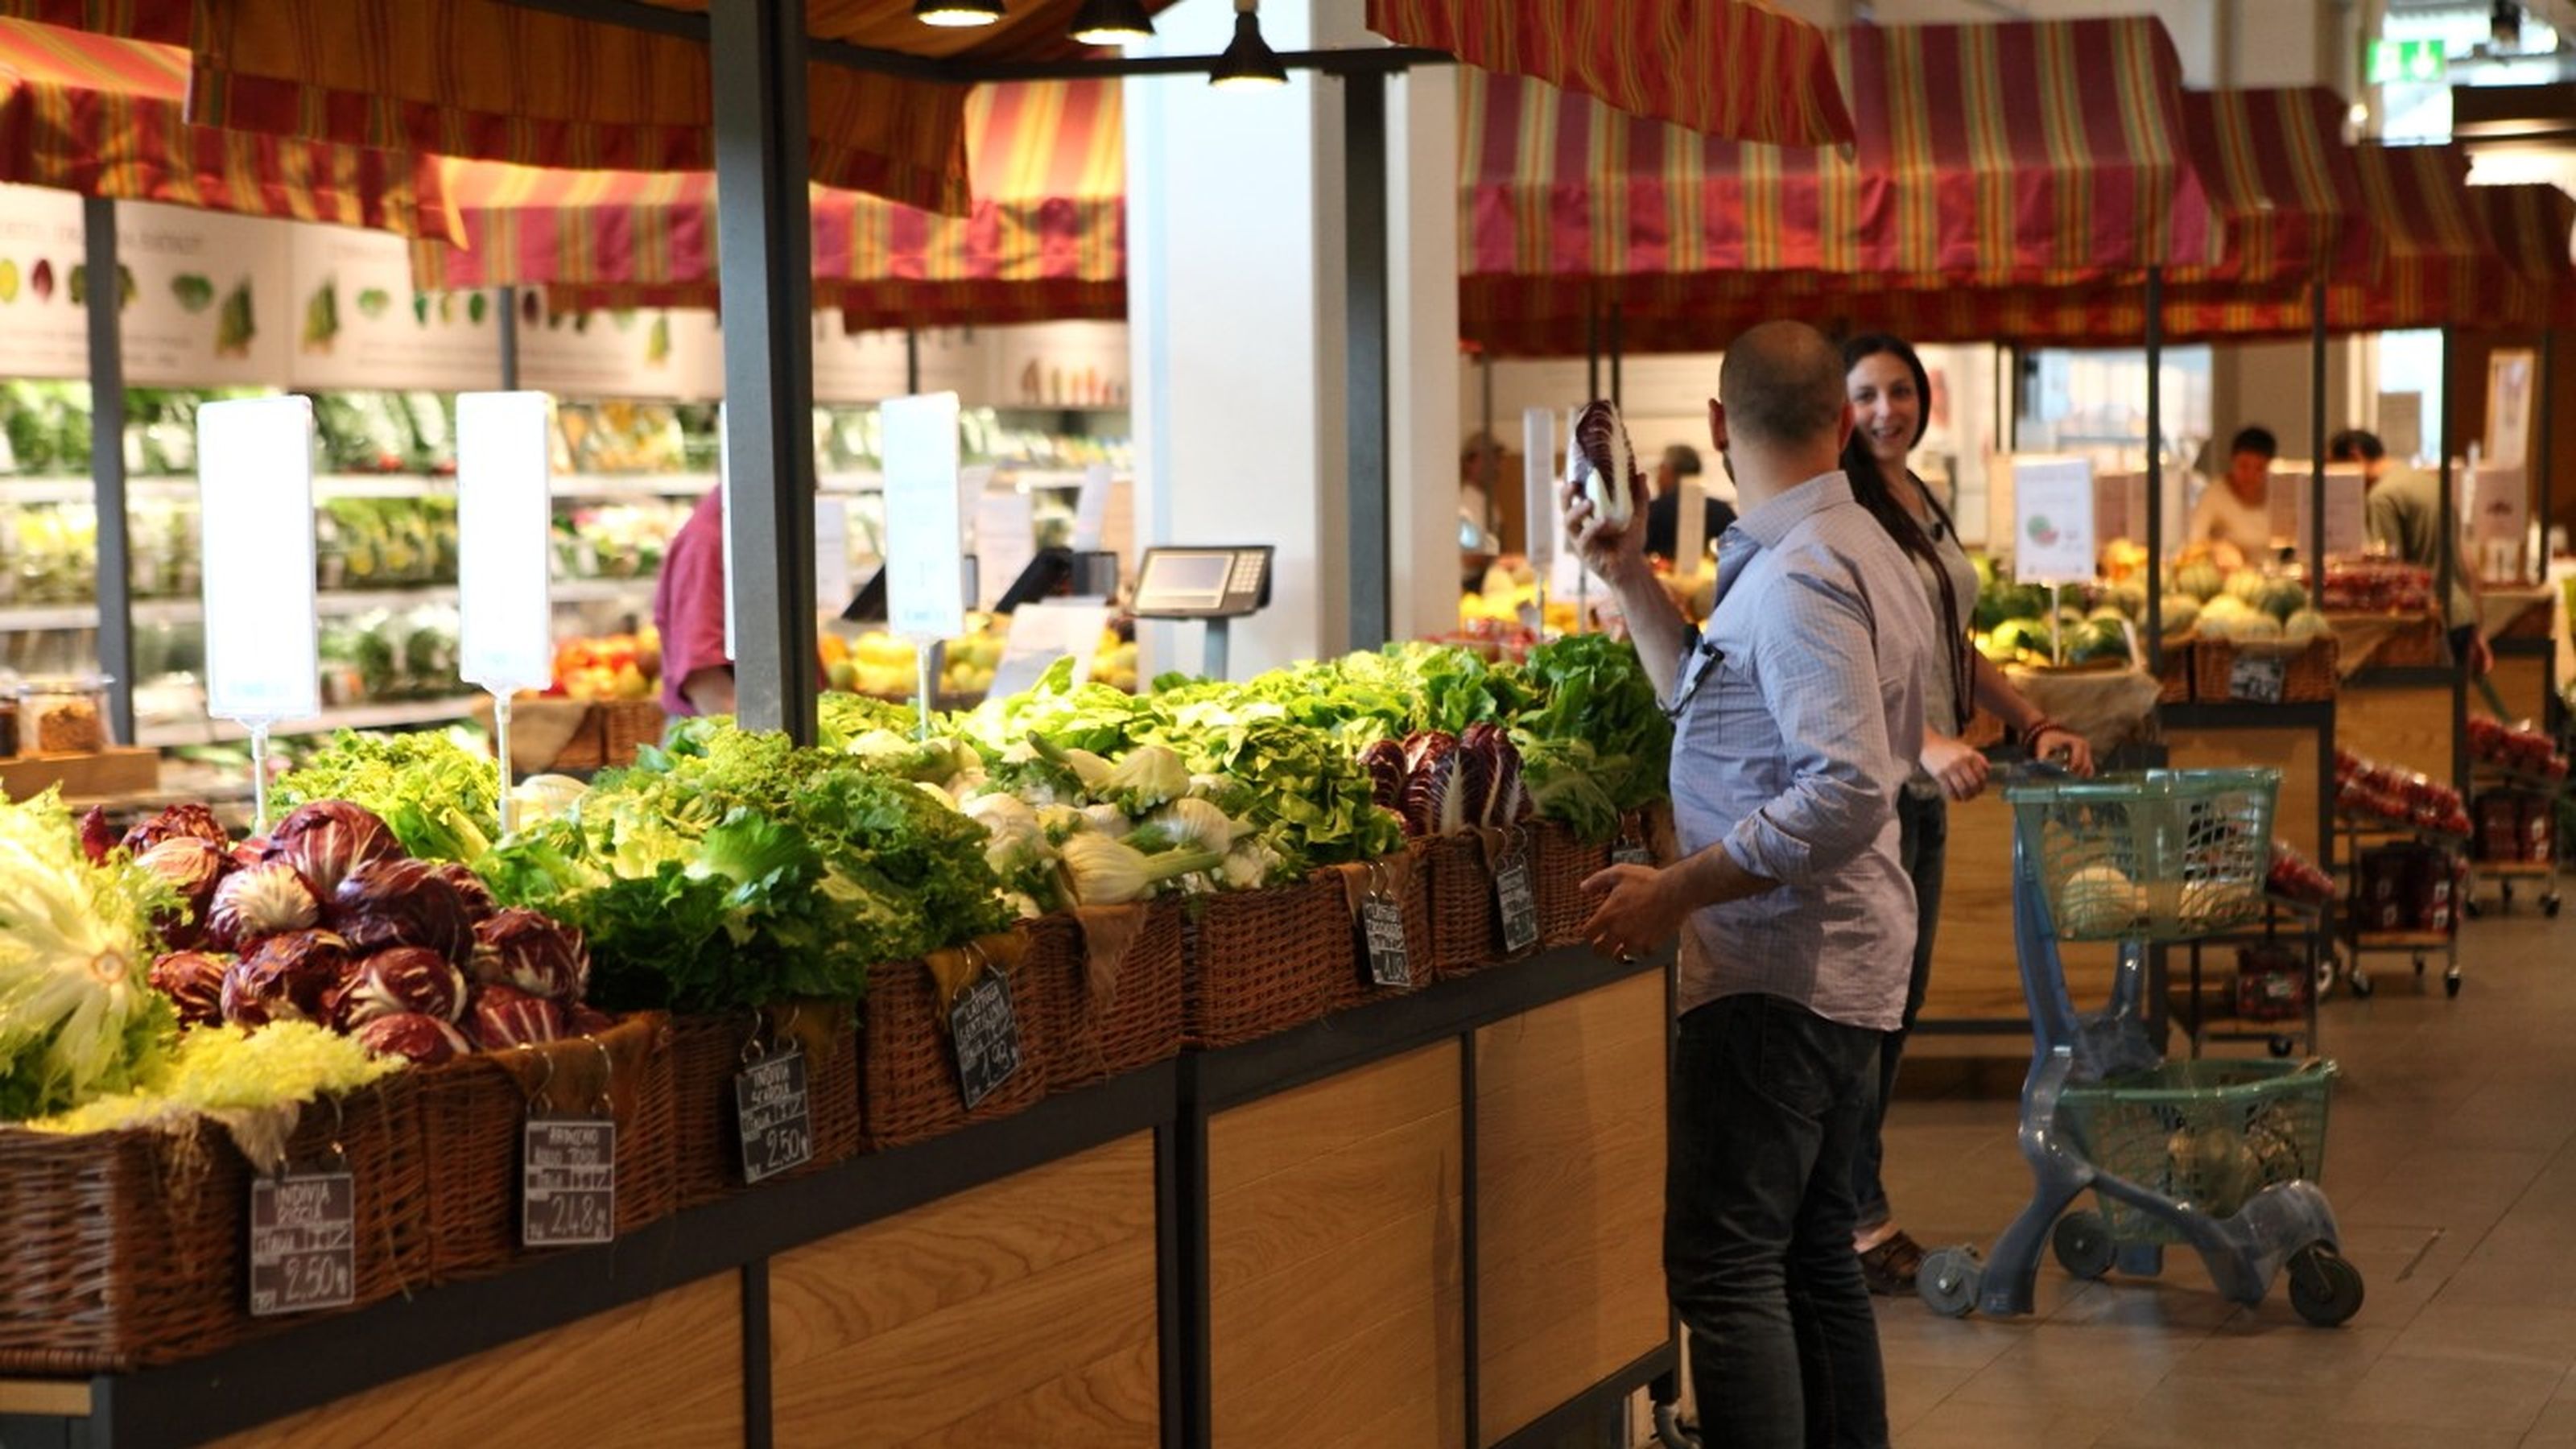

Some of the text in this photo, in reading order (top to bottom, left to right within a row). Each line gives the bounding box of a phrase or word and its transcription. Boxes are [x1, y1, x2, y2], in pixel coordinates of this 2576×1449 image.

[766, 1128, 801, 1170] 2,50
[275, 1181, 332, 1208] INDIVIA
[283, 1255, 335, 1303] 2,50
